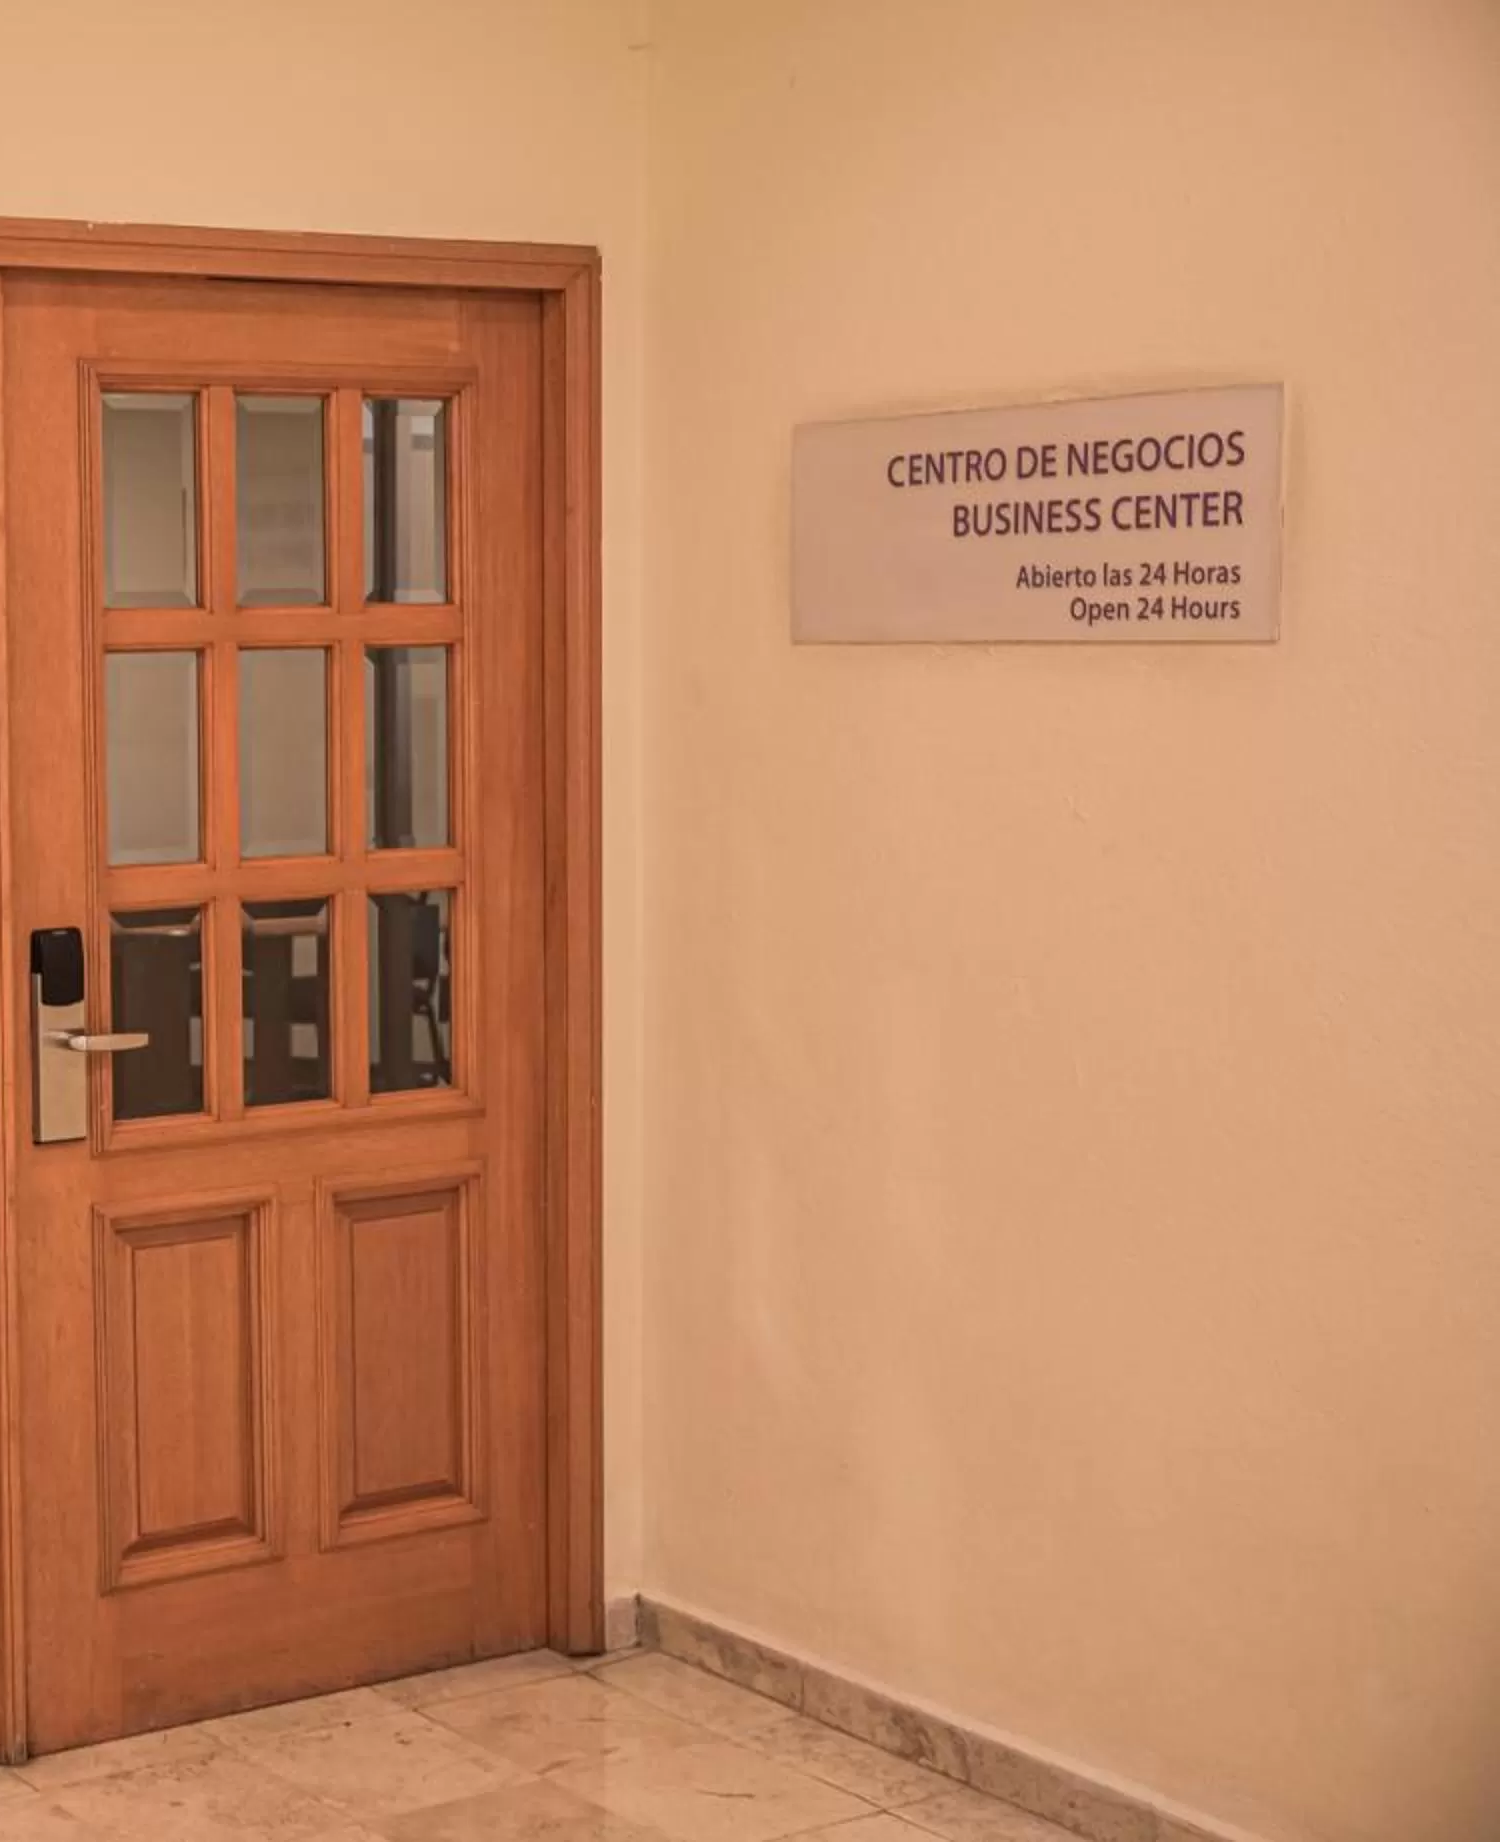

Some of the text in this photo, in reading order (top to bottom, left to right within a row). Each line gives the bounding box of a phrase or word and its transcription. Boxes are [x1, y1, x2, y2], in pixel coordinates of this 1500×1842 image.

[887, 430, 1246, 488] CENTRO DE NEGOCIOS
[952, 490, 1244, 537] BUSINESS CENTER
[1016, 561, 1241, 589] Abierto las 24 Horas
[1070, 595, 1241, 626] Open 24 Hours
